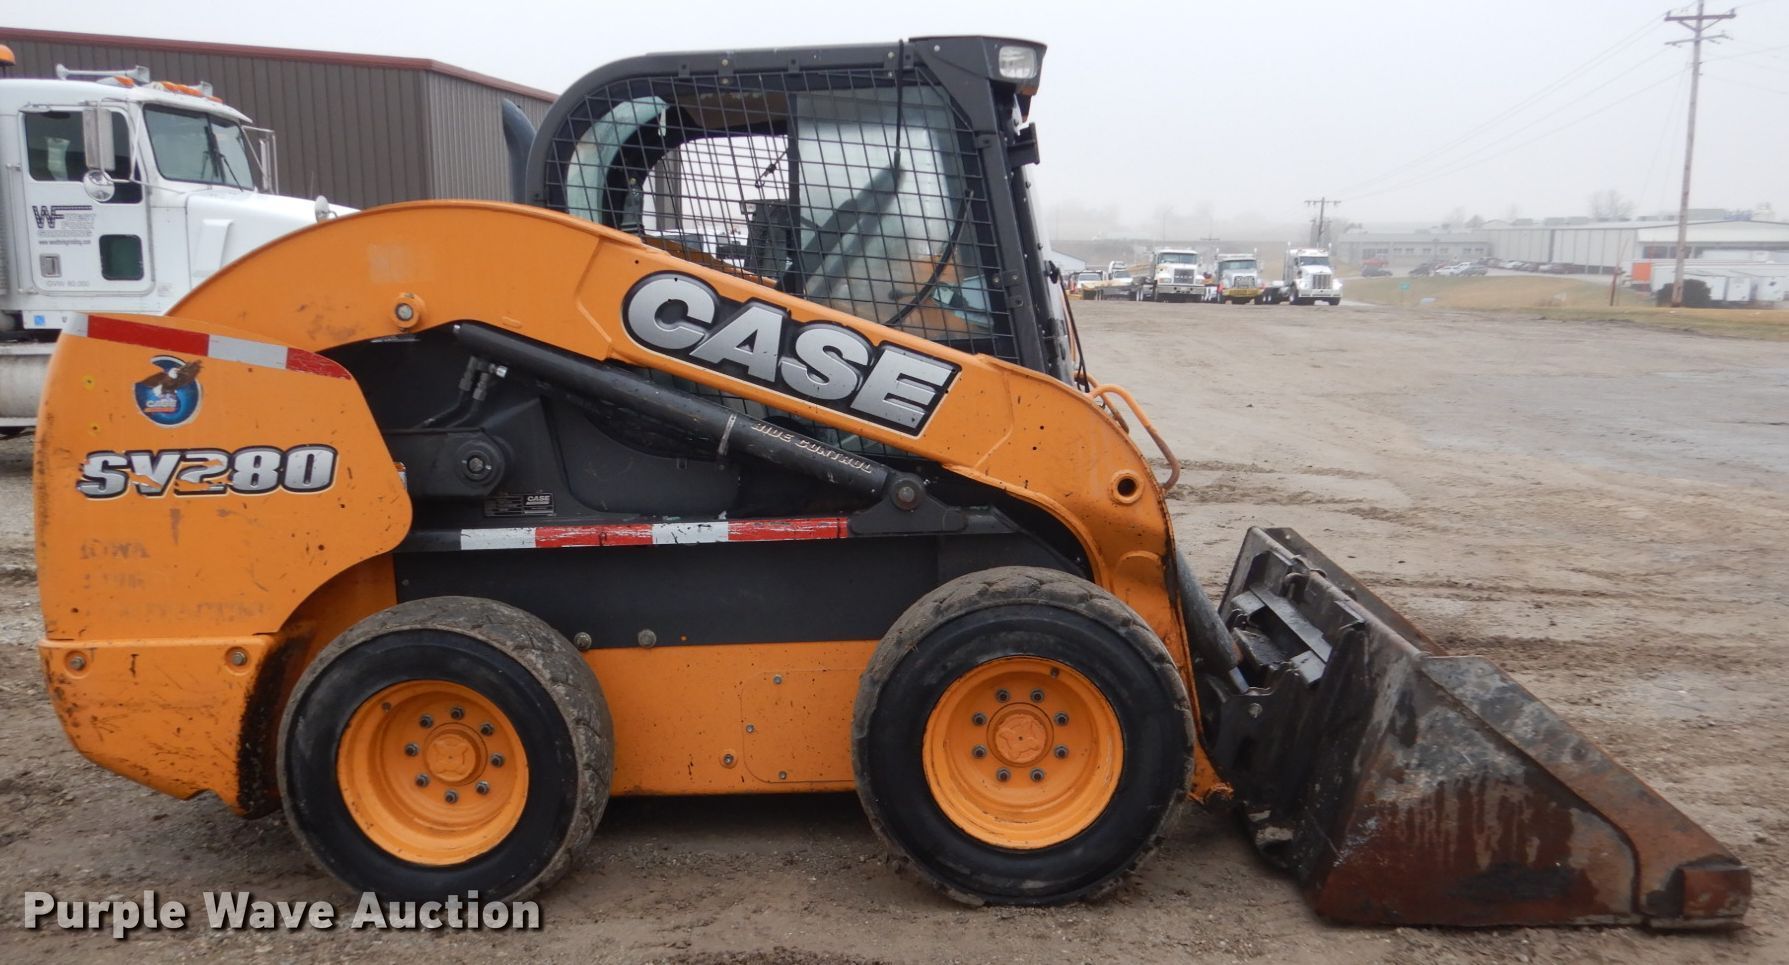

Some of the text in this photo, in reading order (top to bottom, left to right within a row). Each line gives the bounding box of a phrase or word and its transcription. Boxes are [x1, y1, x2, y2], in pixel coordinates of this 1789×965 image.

[625, 272, 957, 431] CASE
[77, 444, 337, 498] SV280
[795, 438, 873, 475] CONTROL
